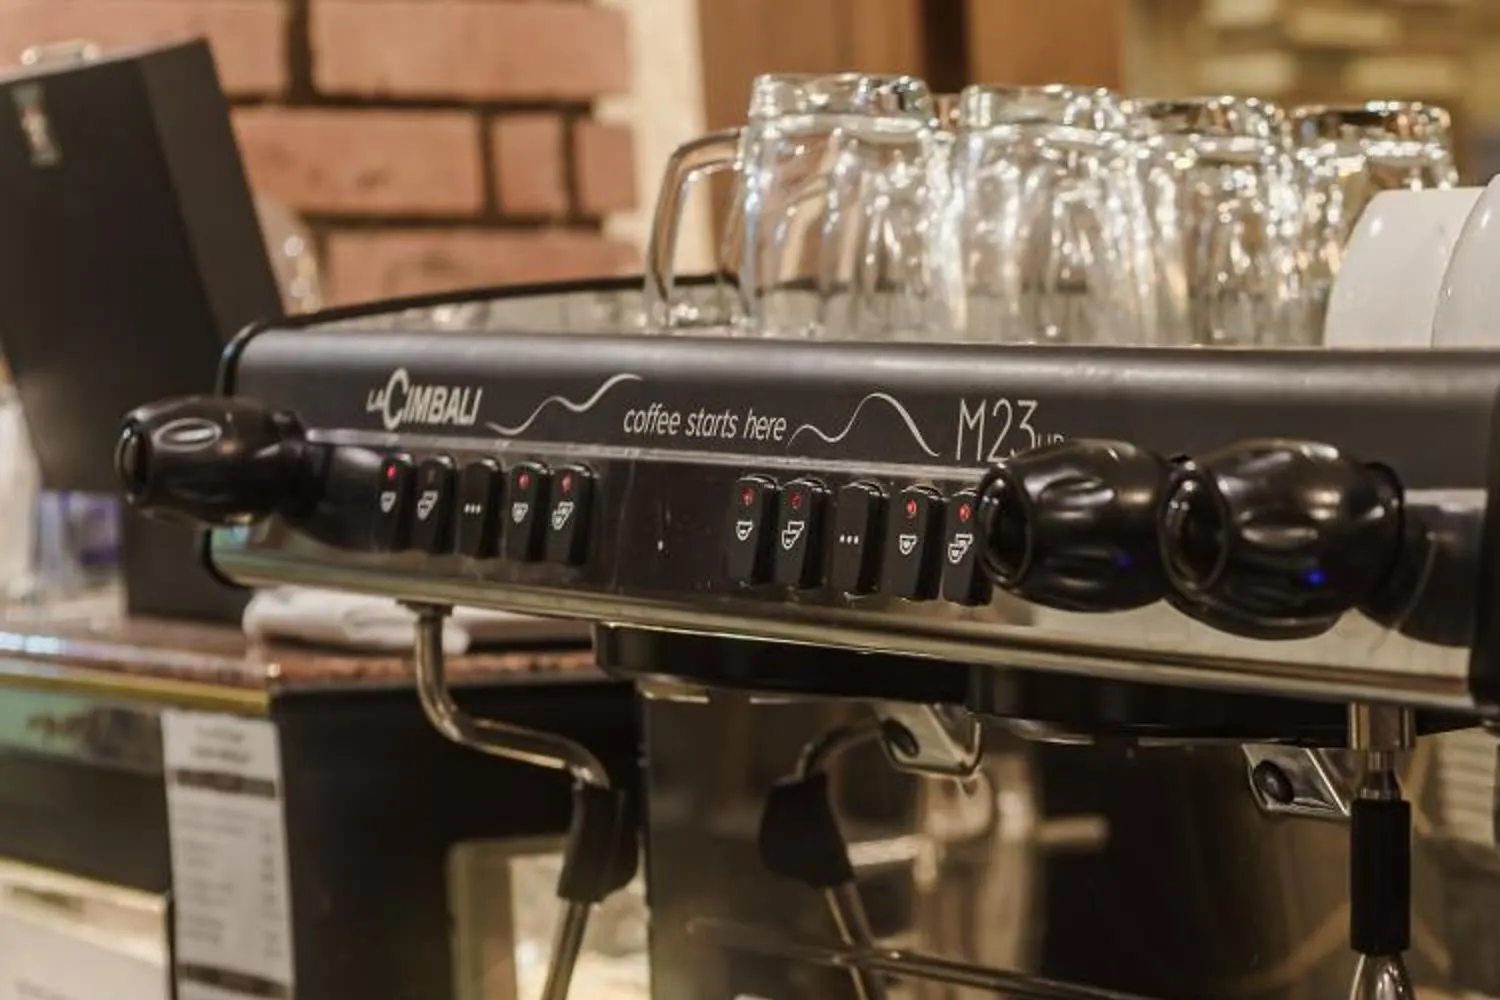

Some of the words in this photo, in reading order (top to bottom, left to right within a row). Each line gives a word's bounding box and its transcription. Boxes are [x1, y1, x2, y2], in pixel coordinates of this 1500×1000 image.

[623, 402, 681, 435] coffee
[685, 407, 739, 439] starts
[743, 408, 788, 441] here
